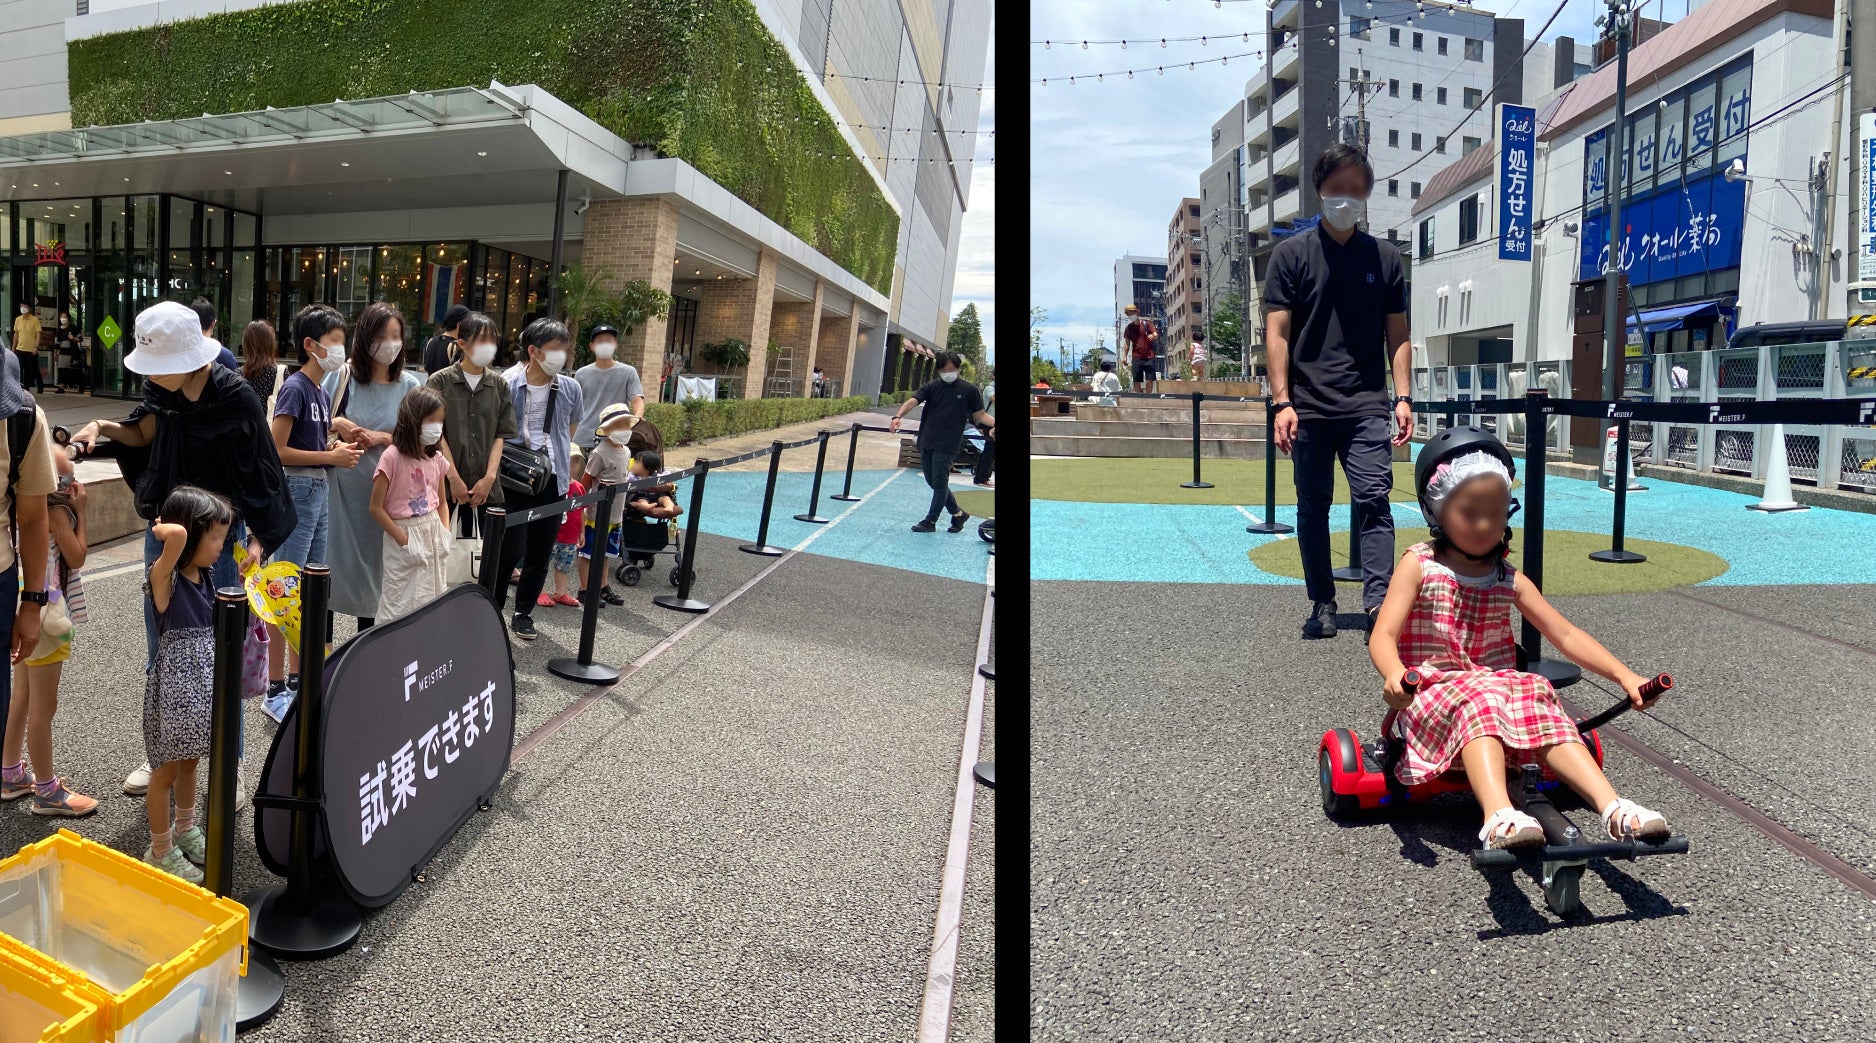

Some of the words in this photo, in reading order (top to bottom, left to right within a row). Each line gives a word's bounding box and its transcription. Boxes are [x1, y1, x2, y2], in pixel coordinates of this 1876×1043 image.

[1507, 147, 1528, 239] 処方せん
[1505, 240, 1526, 253] 受付
[1640, 212, 1720, 261] クオール薬局
[1718, 413, 1746, 422] MEISTER.F
[418, 659, 453, 693] MEISTER.F
[359, 680, 496, 846] 試乗できます
